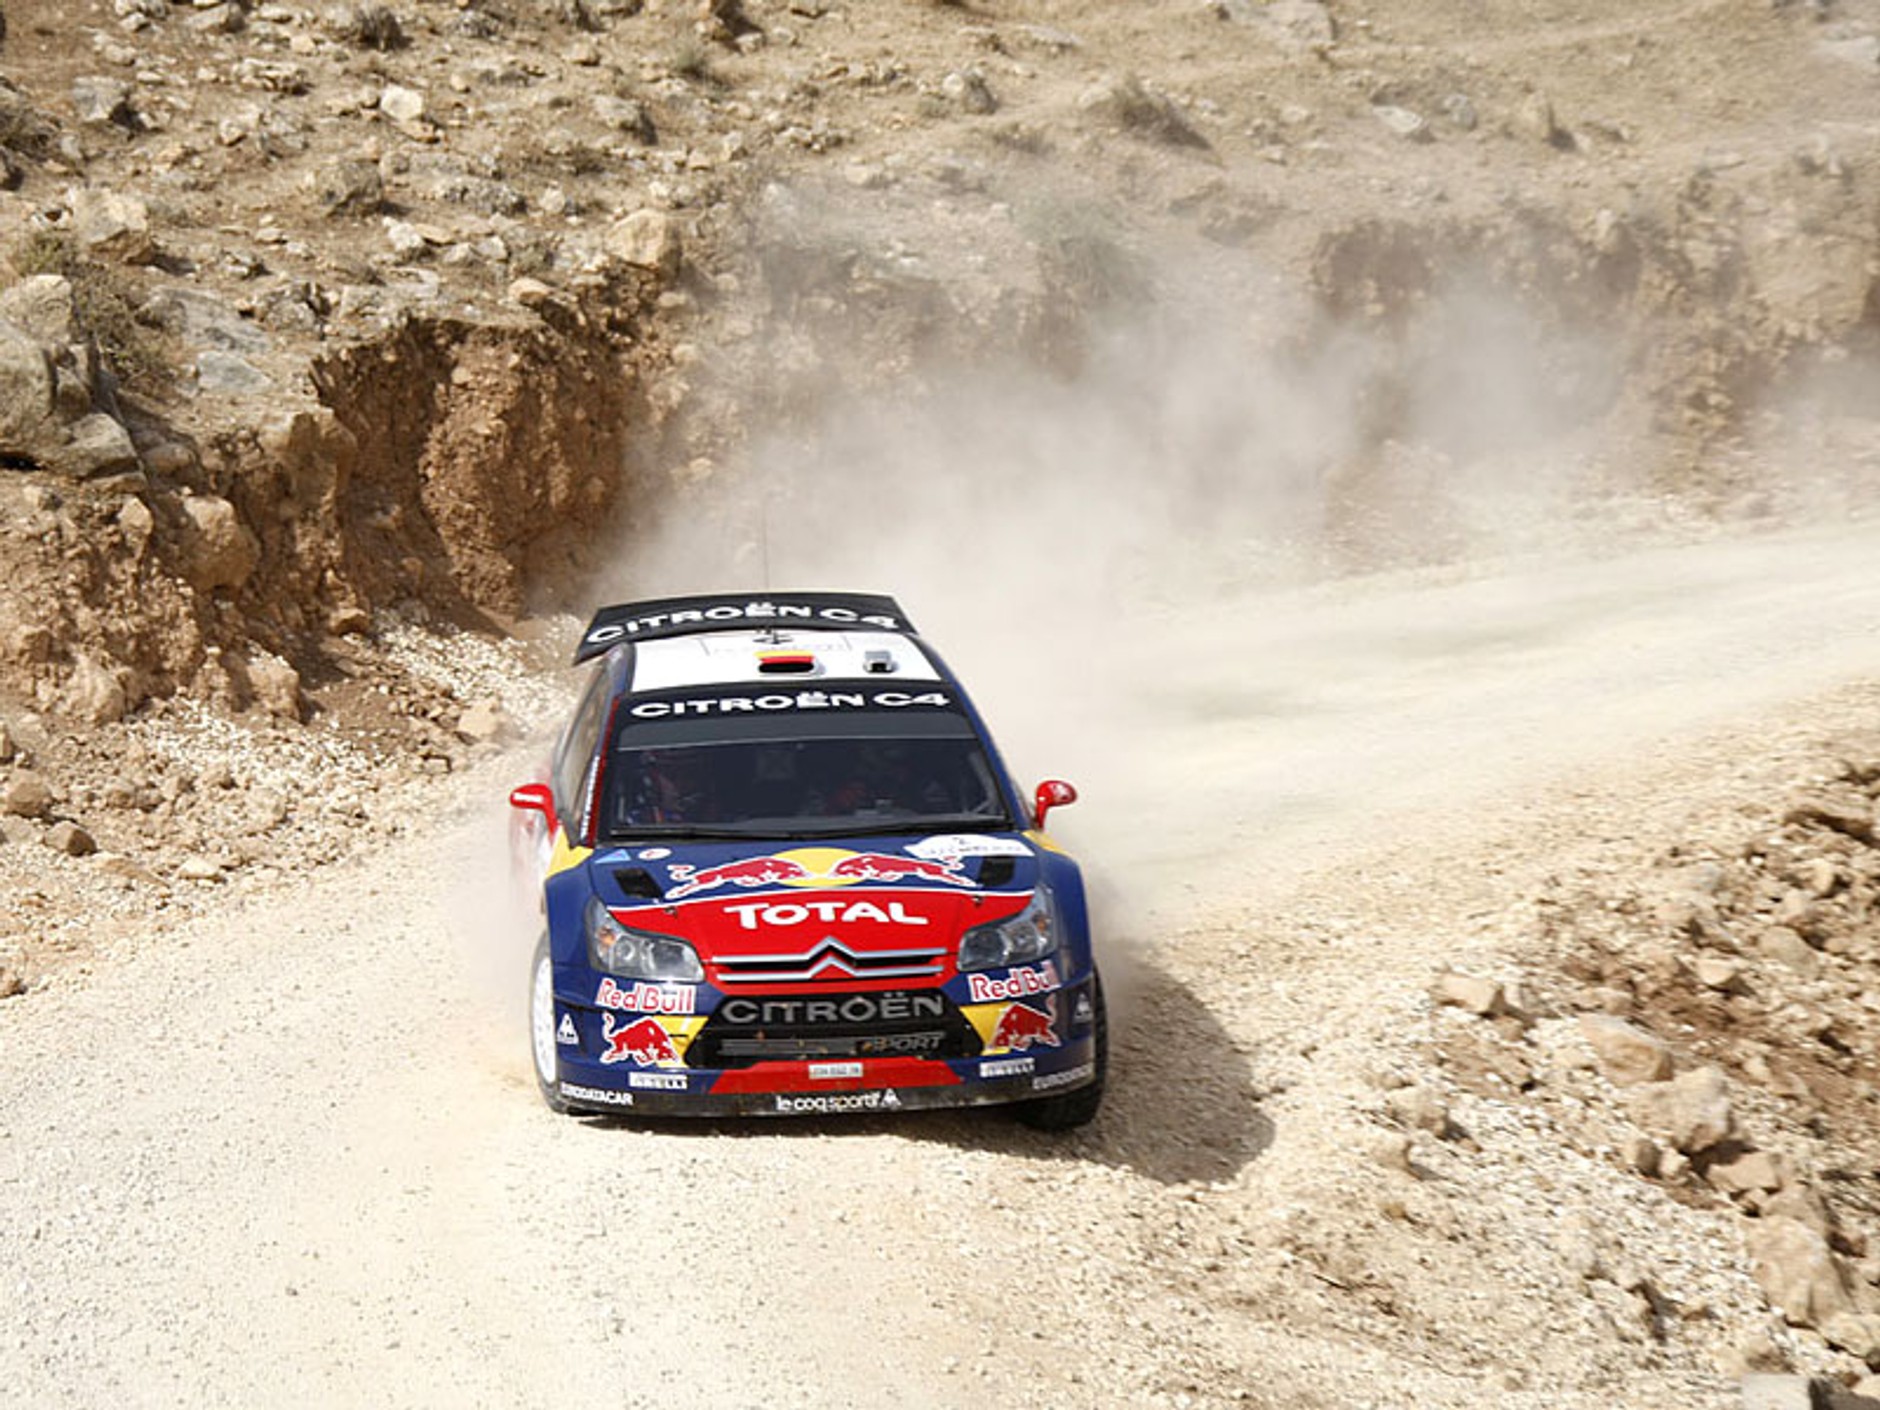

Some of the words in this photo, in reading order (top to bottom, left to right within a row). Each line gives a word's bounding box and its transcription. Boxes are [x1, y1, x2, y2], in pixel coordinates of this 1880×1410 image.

[587, 602, 812, 643] CITROËN
[820, 608, 900, 629] C4
[631, 691, 865, 717] CITROËN
[873, 692, 950, 706] C4
[723, 901, 930, 930] TOTAL
[598, 979, 641, 1010] Red
[641, 984, 694, 1013] Bull
[970, 969, 1022, 1000] Red
[721, 992, 944, 1024] CITROËN
[776, 1095, 792, 1110] le
[793, 1097, 829, 1112] coq
